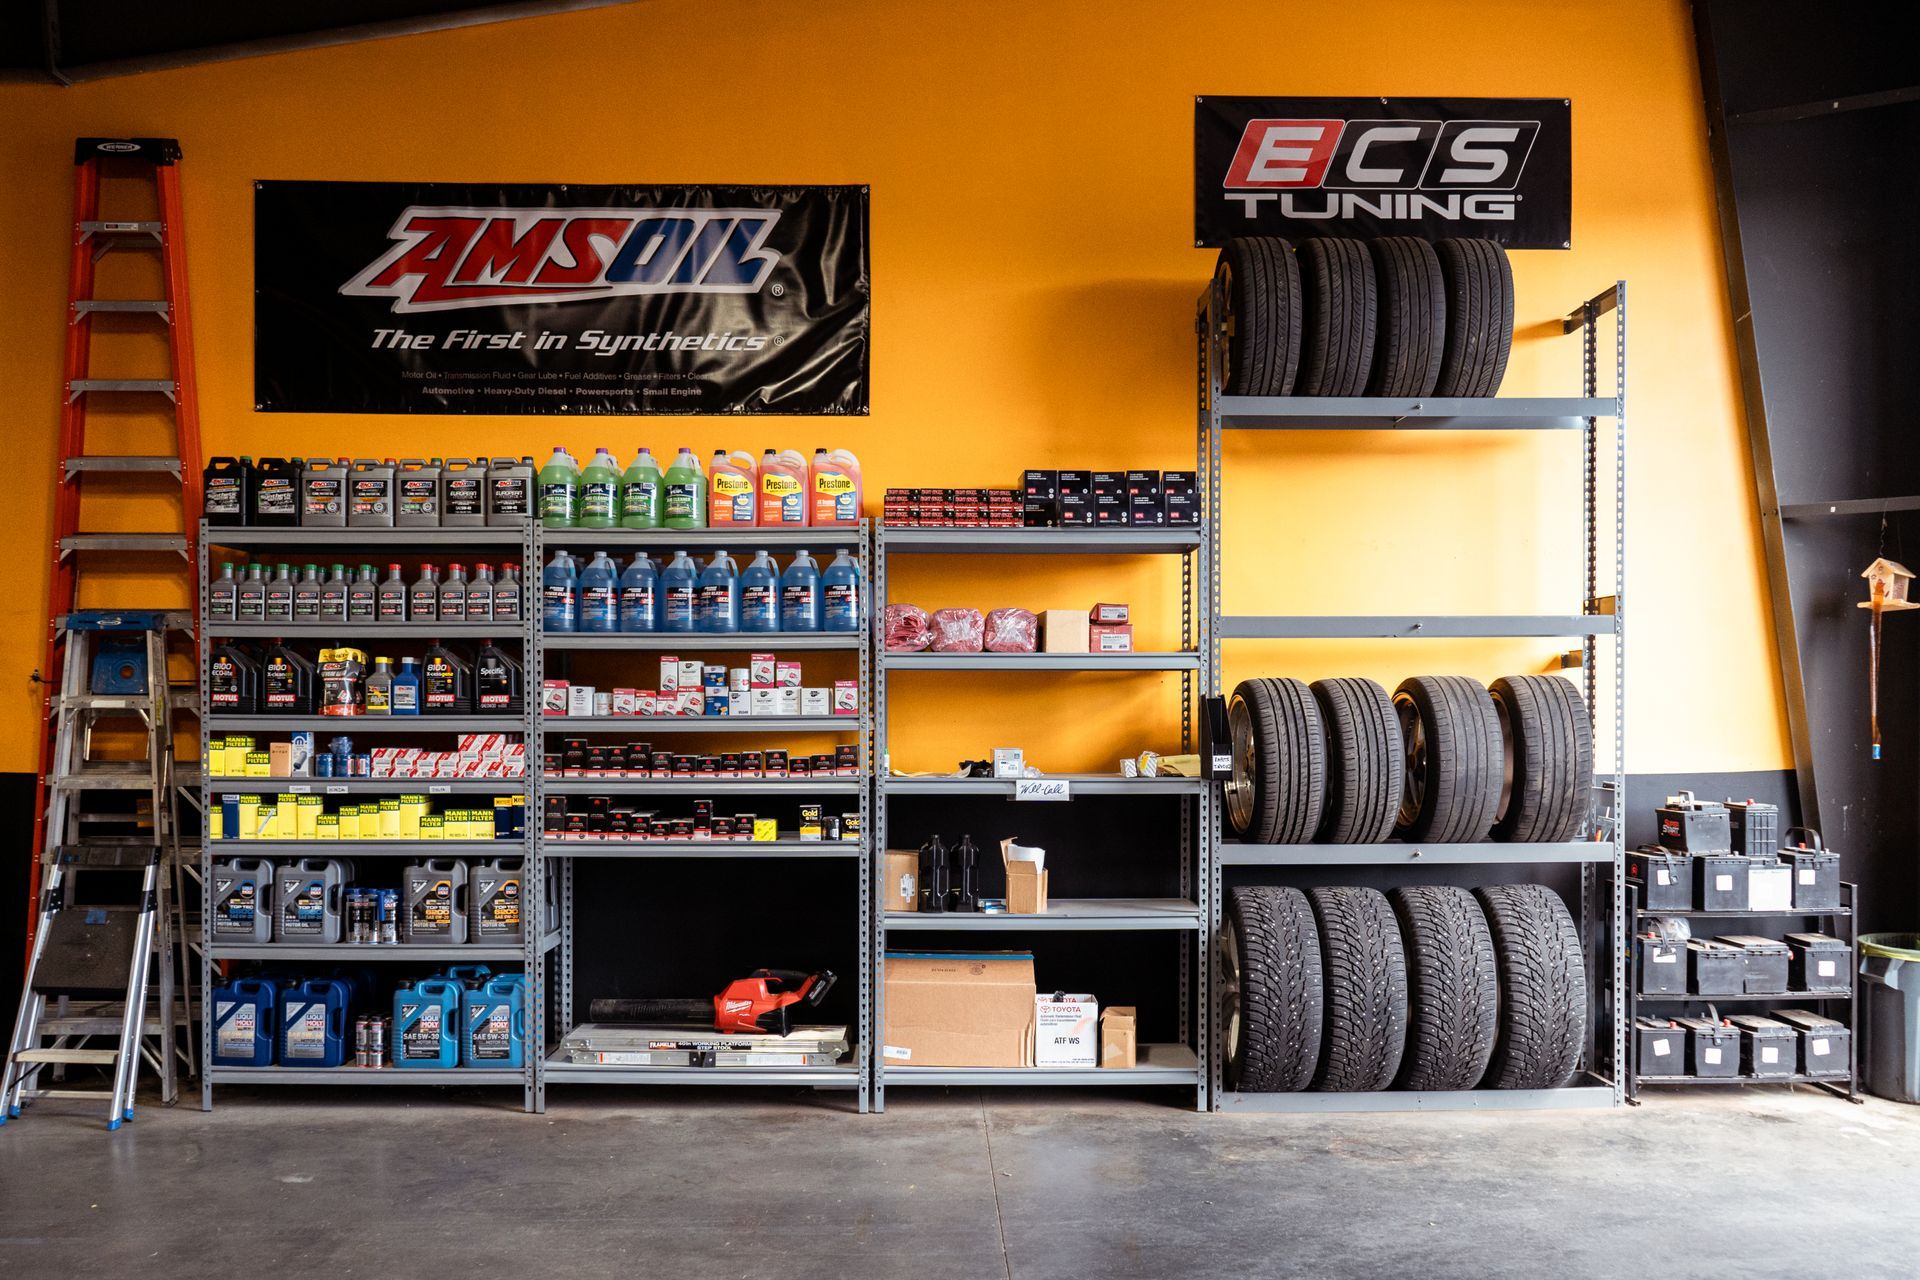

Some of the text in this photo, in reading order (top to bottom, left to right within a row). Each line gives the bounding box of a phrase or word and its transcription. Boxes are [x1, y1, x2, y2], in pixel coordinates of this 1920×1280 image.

[1245, 126, 1521, 183] ECS
[1224, 193, 1515, 220] TUNING
[338, 205, 783, 313] AMSOIL
[371, 329, 765, 356] The First in Synthetics
[401, 371, 681, 380] Motor Oil Transmission Fluid Gear Lube Fuel Additives Grease Filters
[422, 386, 702, 397] Automotive Heavy-Duty Diesel Powersports Small Engine
[717, 478, 749, 490] Prestone
[766, 479, 797, 490] Prestone
[819, 478, 851, 489] Prestone
[480, 667, 504, 676] Specific
[481, 695, 509, 703] MOTUL
[802, 809, 818, 817] Gold
[1054, 1036, 1080, 1045] ATF WS
